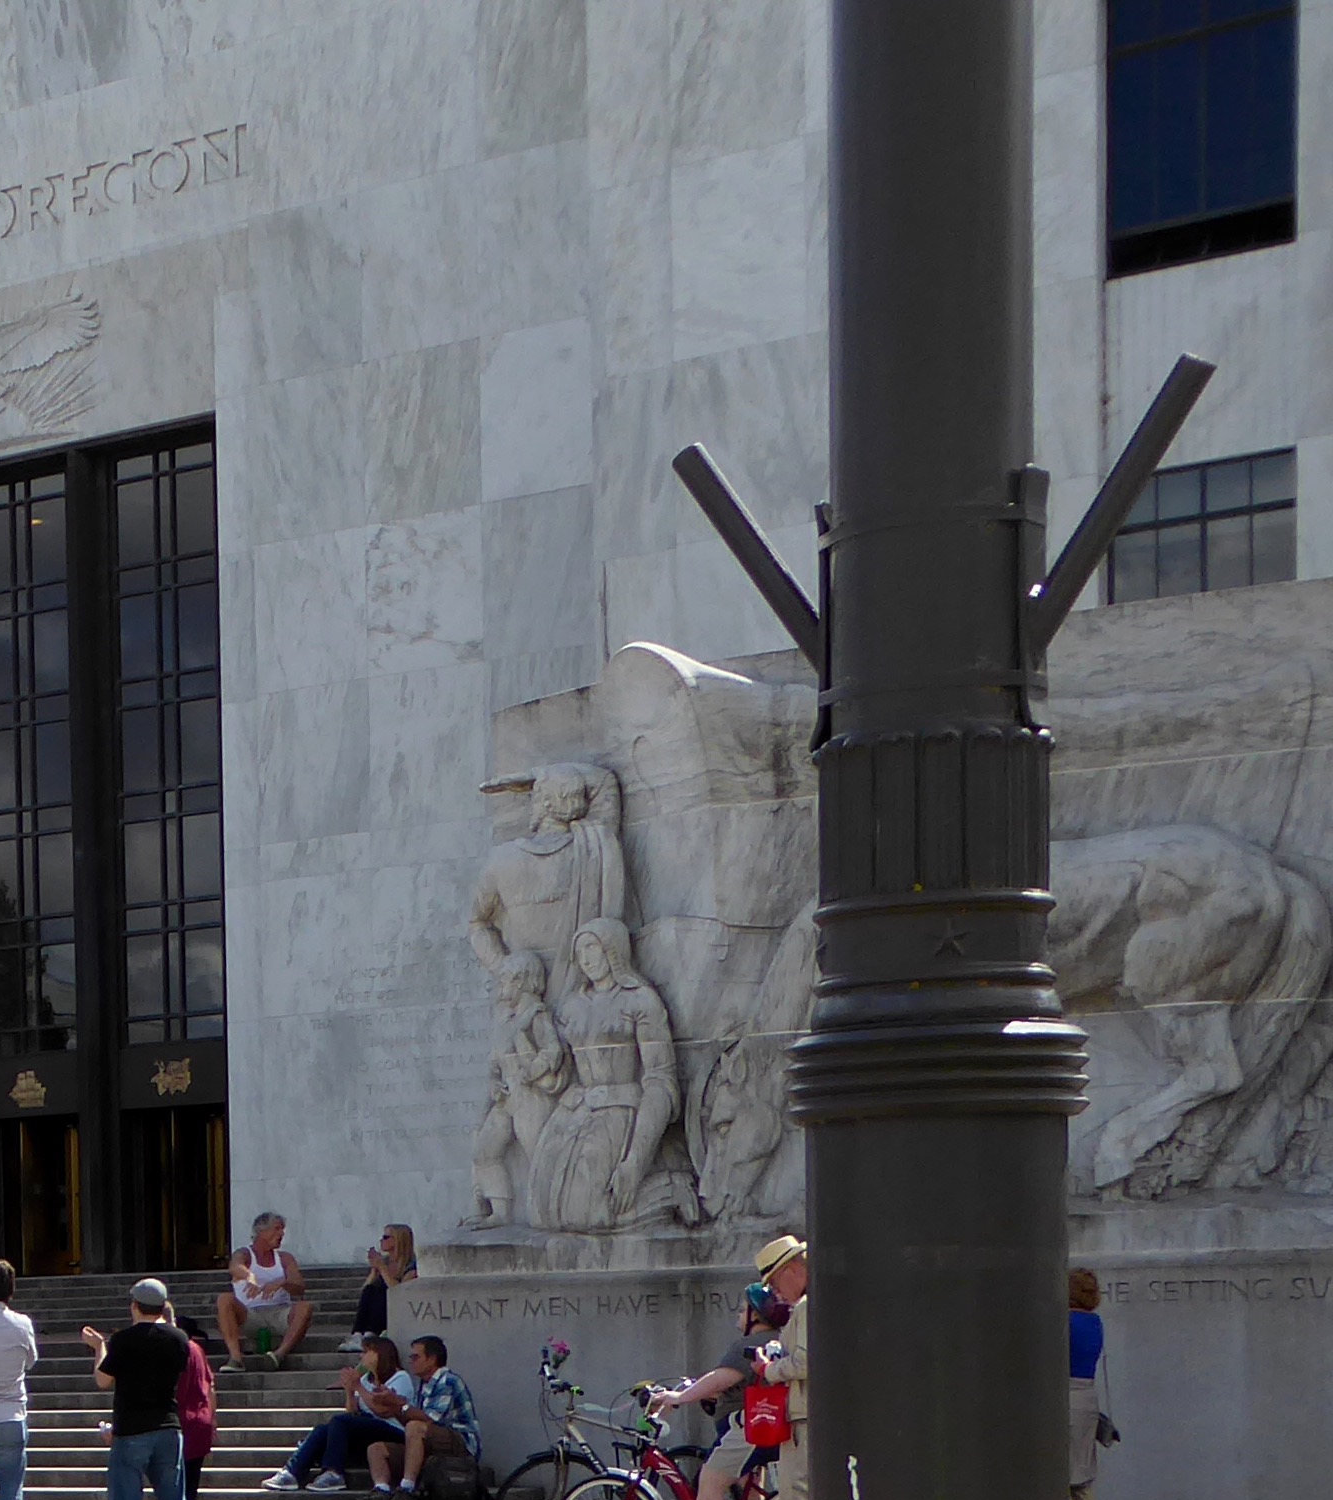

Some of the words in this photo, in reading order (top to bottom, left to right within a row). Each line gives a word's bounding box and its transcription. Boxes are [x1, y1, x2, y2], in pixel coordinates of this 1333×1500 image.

[407, 1298, 510, 1321] VALIANT
[523, 1296, 582, 1318] MEN
[597, 1294, 662, 1317] HAVE
[672, 1292, 743, 1315] THRU
[1100, 1281, 1131, 1303] HE
[1149, 1279, 1274, 1303] SETTING
[1289, 1276, 1332, 1301] SU
